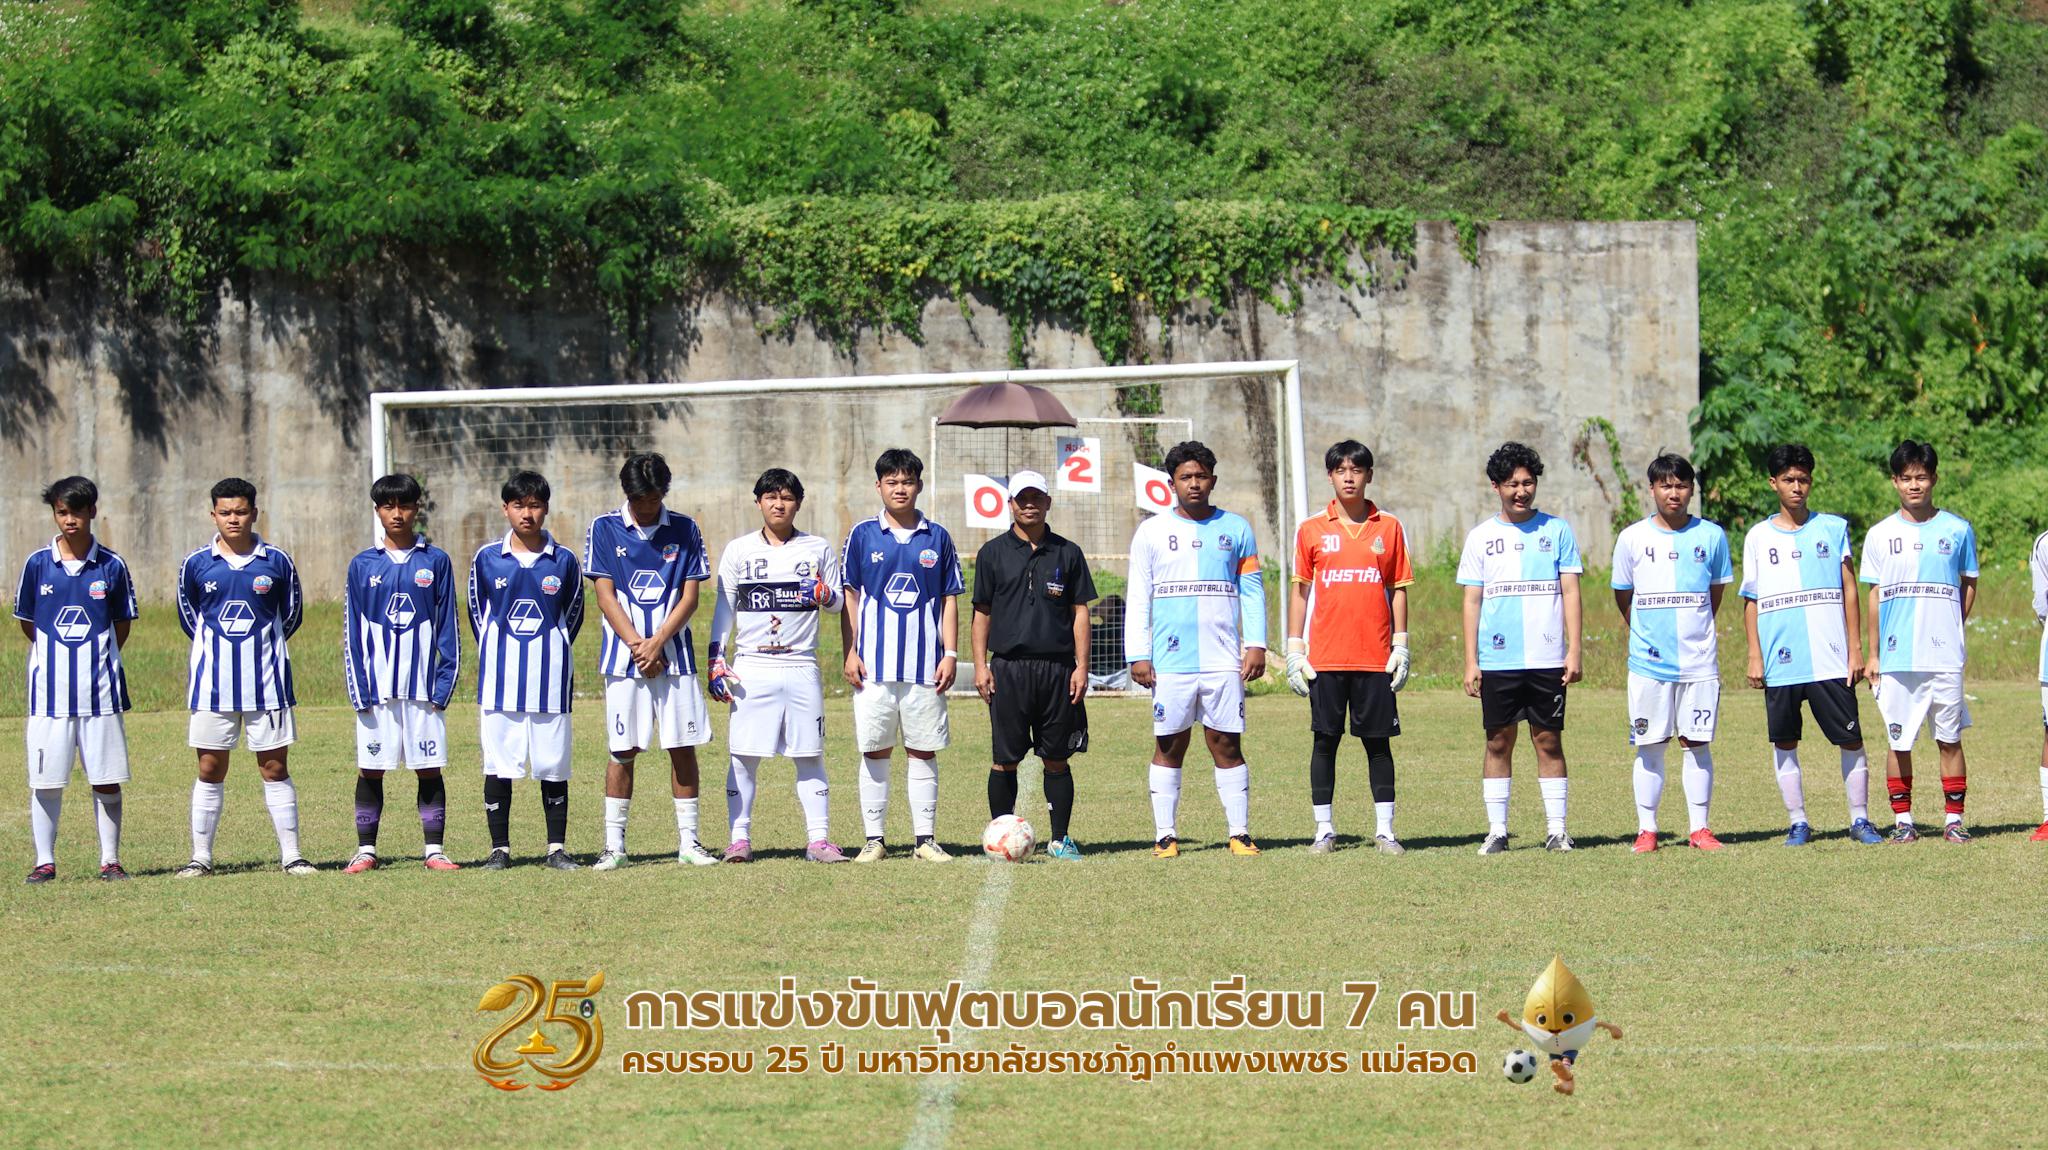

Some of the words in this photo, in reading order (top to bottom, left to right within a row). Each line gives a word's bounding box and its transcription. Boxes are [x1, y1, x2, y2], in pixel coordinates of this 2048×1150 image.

[1065, 457, 1093, 483] 2
[1168, 535, 1178, 551] 8
[1321, 534, 1340, 553] 30
[1486, 538, 1504, 556] 20
[1889, 537, 1902, 555] 10
[1645, 546, 1655, 563] 4
[1769, 548, 1779, 565] 8
[1169, 585, 1188, 594] STAR
[1189, 584, 1223, 593] FOOTBALL
[1495, 586, 1512, 594] STAR
[1514, 584, 1546, 592] FOOTBALL
[1909, 585, 1941, 594] FOOTBALL
[1648, 596, 1665, 605] STAR
[1667, 595, 1699, 604] FOOTBALL
[1775, 597, 1793, 606] STAR
[1795, 592, 1828, 602] FOOTBALL
[615, 713, 625, 736] 6
[419, 740, 437, 757] 42
[38, 748, 44, 774] 1
